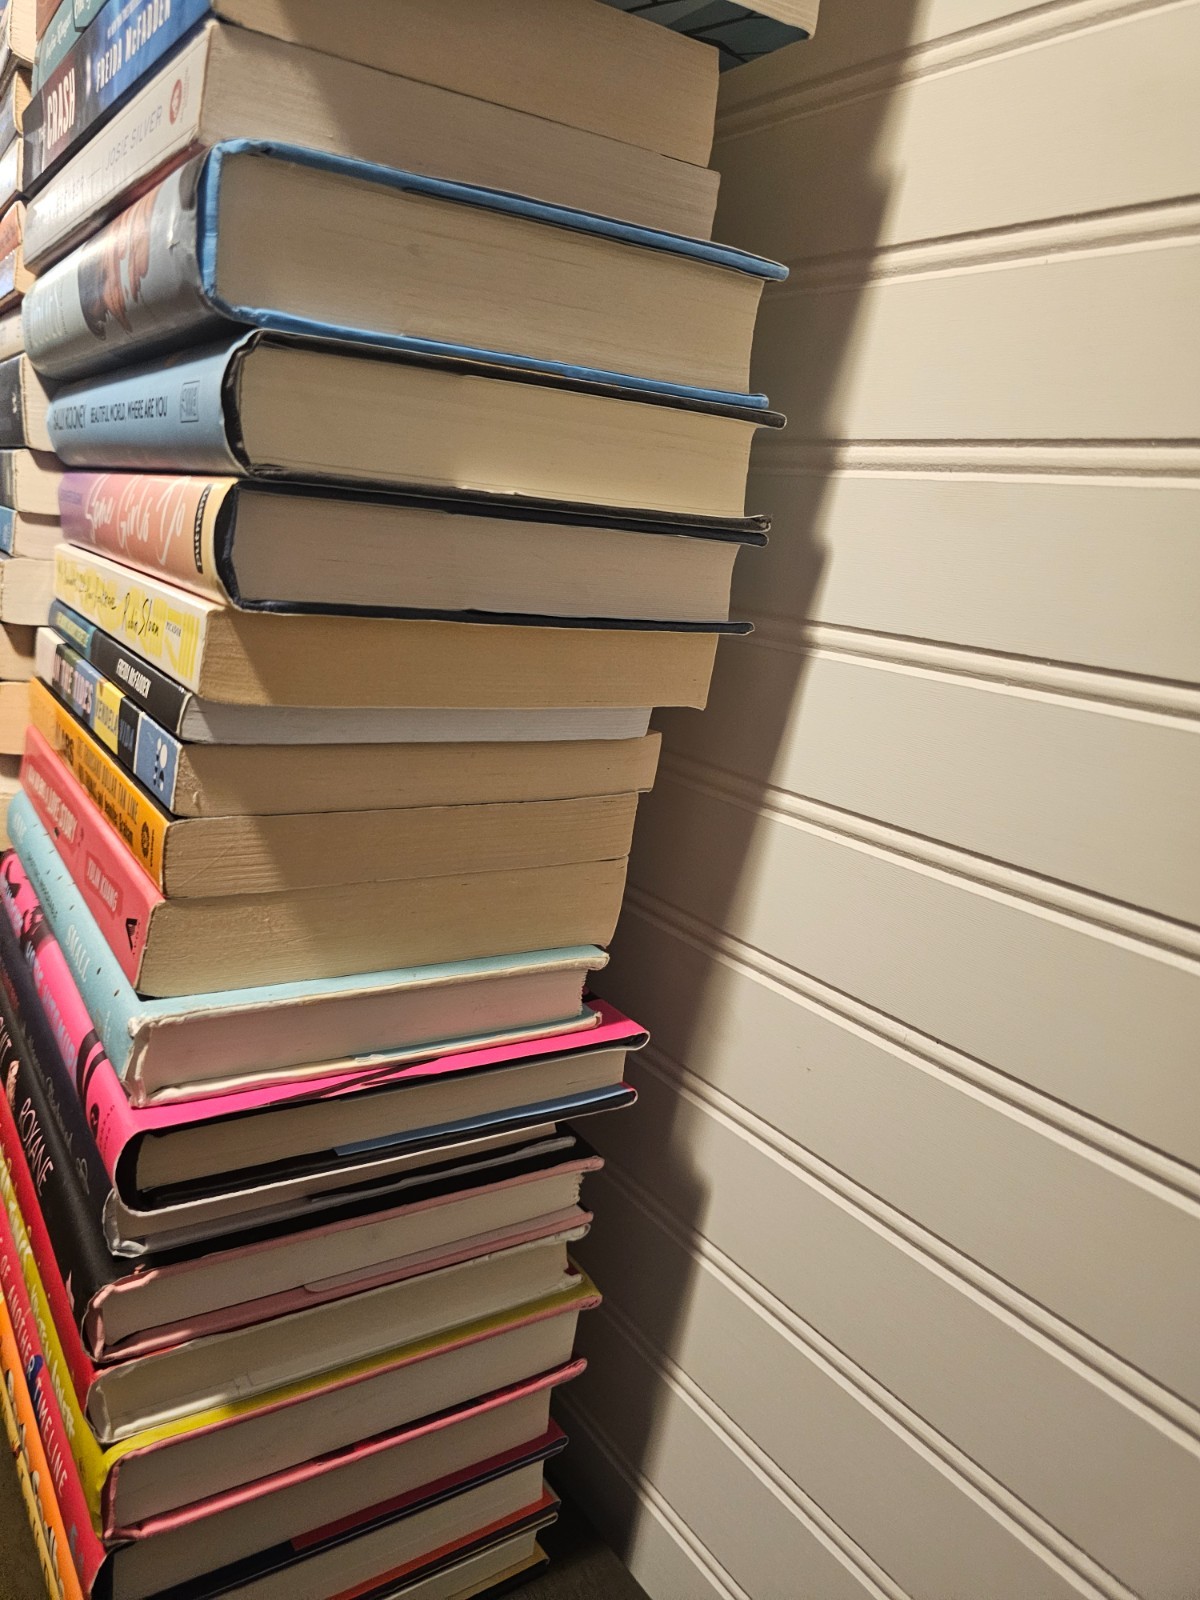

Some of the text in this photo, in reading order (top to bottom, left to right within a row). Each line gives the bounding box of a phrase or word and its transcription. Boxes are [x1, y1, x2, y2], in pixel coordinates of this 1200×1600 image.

[96, 38, 122, 93] FREIDA
[125, 0, 171, 63] McFADDEN
[47, 67, 76, 150] CRASH
[105, 106, 162, 171] JOSIE SILVER
[53, 404, 87, 430] SALLY ROONEY
[127, 399, 144, 420] WHERE
[144, 396, 154, 418] ARE
[155, 395, 168, 417] YOU
[116, 474, 153, 558] Girls
[194, 486, 212, 569] putnam
[122, 592, 138, 632] Robin
[138, 598, 159, 637] Sloan
[165, 621, 182, 637] PICADOR
[73, 671, 93, 714] TIDES
[116, 658, 152, 699] FREIDA McFADDEN
[65, 924, 91, 982] SMALL
[18, 1097, 54, 1196] ROXANE
[8, 1284, 36, 1376] ANOTHER
[35, 1377, 68, 1498] TIMELINE
